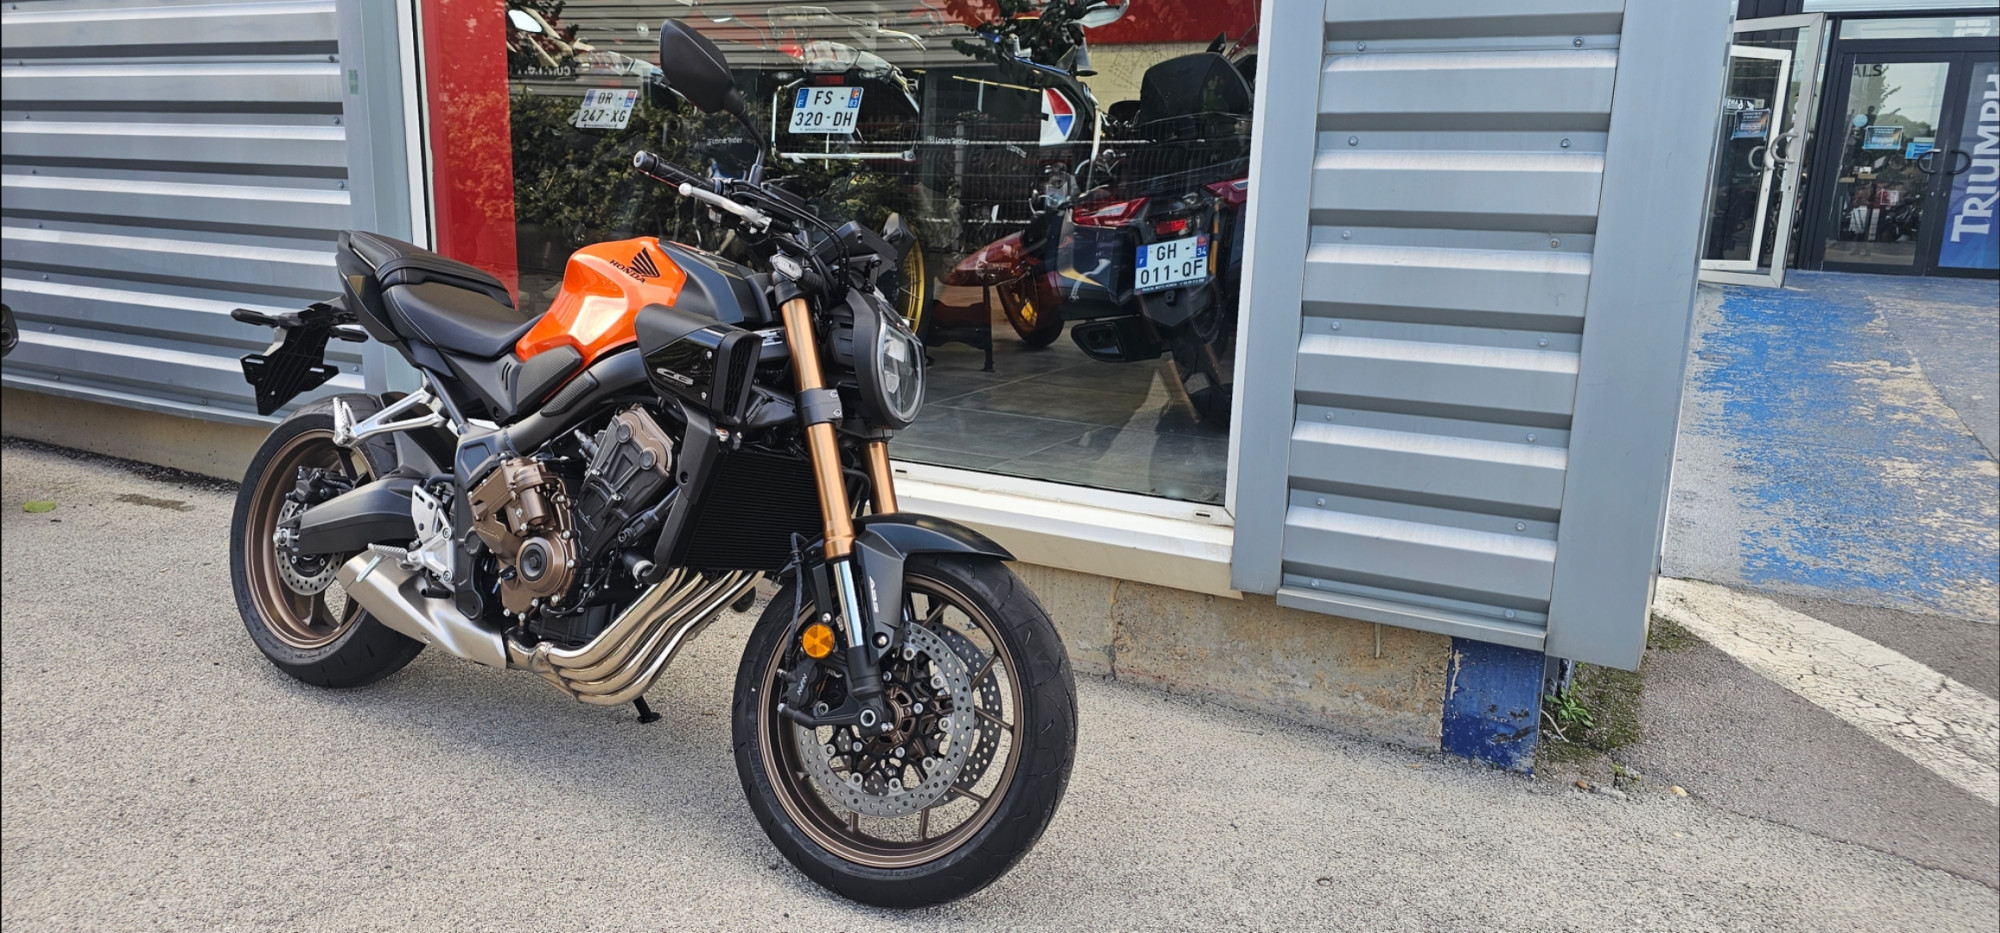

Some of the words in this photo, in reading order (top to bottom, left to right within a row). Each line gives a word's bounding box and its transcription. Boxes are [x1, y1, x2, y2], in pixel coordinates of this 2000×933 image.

[598, 92, 613, 104] DR
[814, 90, 833, 105] FS
[581, 109, 627, 122] 247-XG
[795, 111, 853, 126] 320-DH
[1156, 243, 1177, 261] GH
[1197, 246, 1207, 256] 34
[609, 259, 646, 285] HONDA
[1140, 259, 1204, 285] 011-QF
